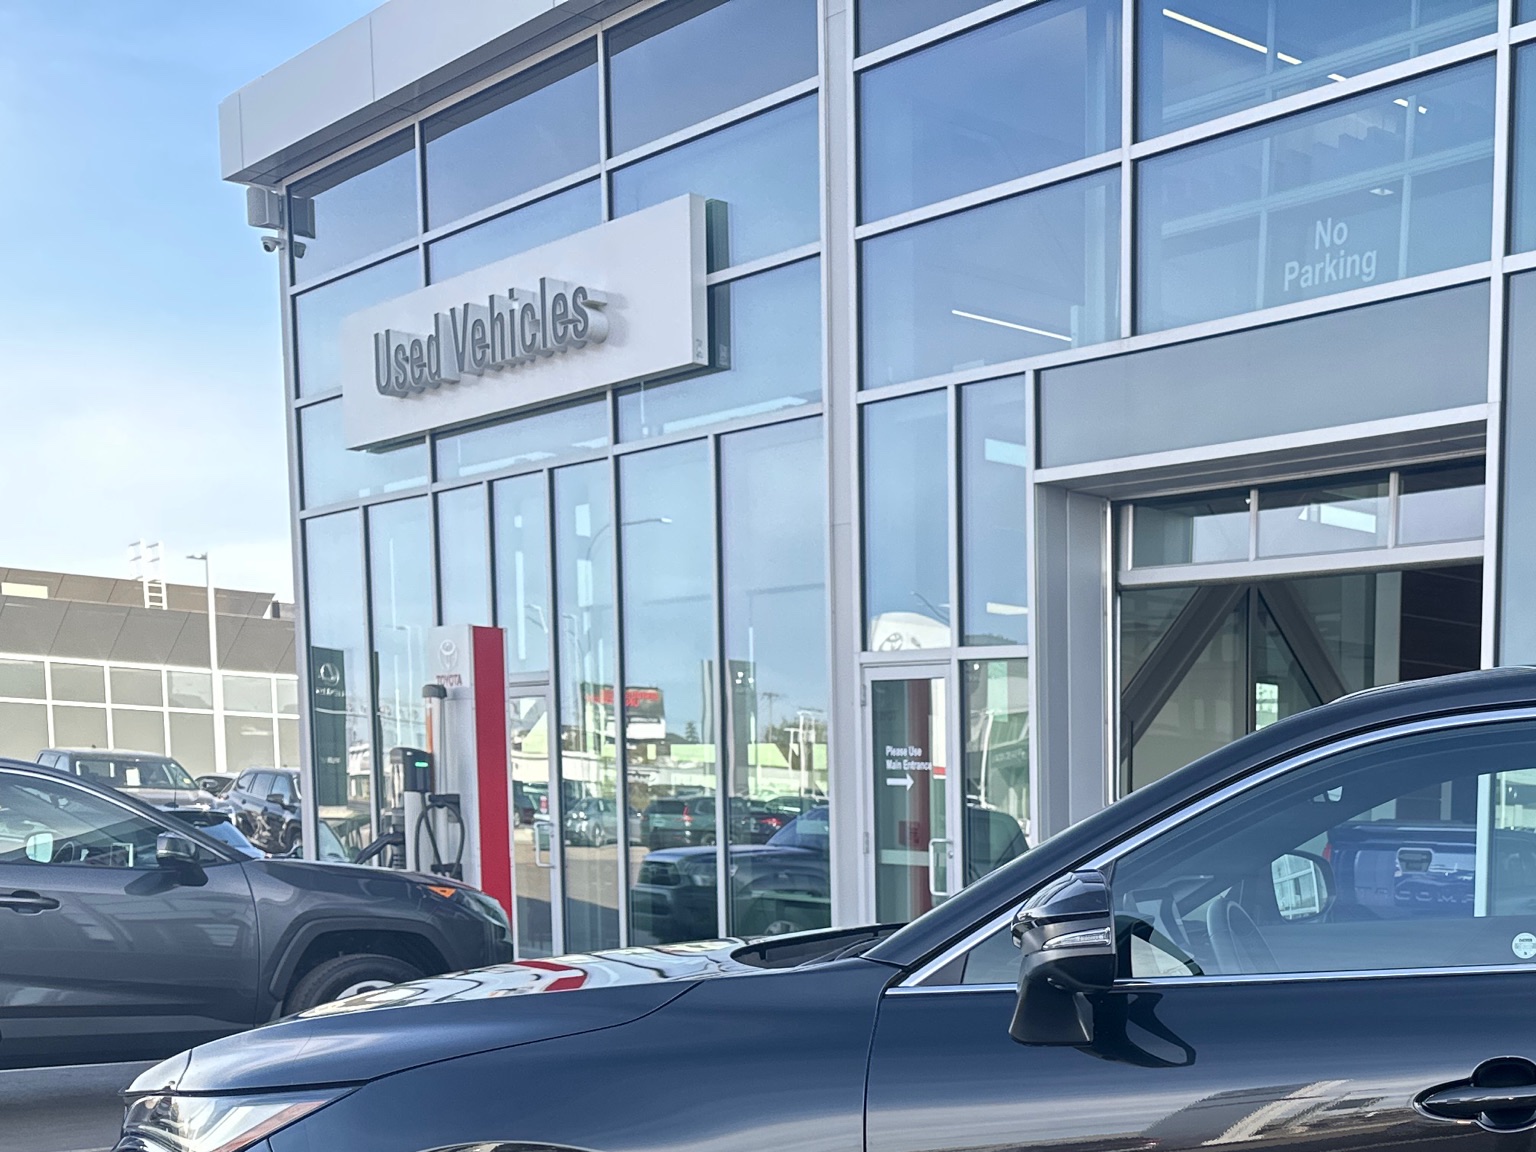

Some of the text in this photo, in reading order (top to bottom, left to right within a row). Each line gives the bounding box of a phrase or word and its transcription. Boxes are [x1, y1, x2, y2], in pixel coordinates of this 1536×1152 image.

[1314, 217, 1348, 250] No
[1283, 249, 1377, 291] Parking
[373, 277, 594, 397] Used Vehicles
[436, 674, 463, 686] TOYOTA
[885, 745, 923, 757] Please Use
[885, 759, 932, 771] Main Entrance
